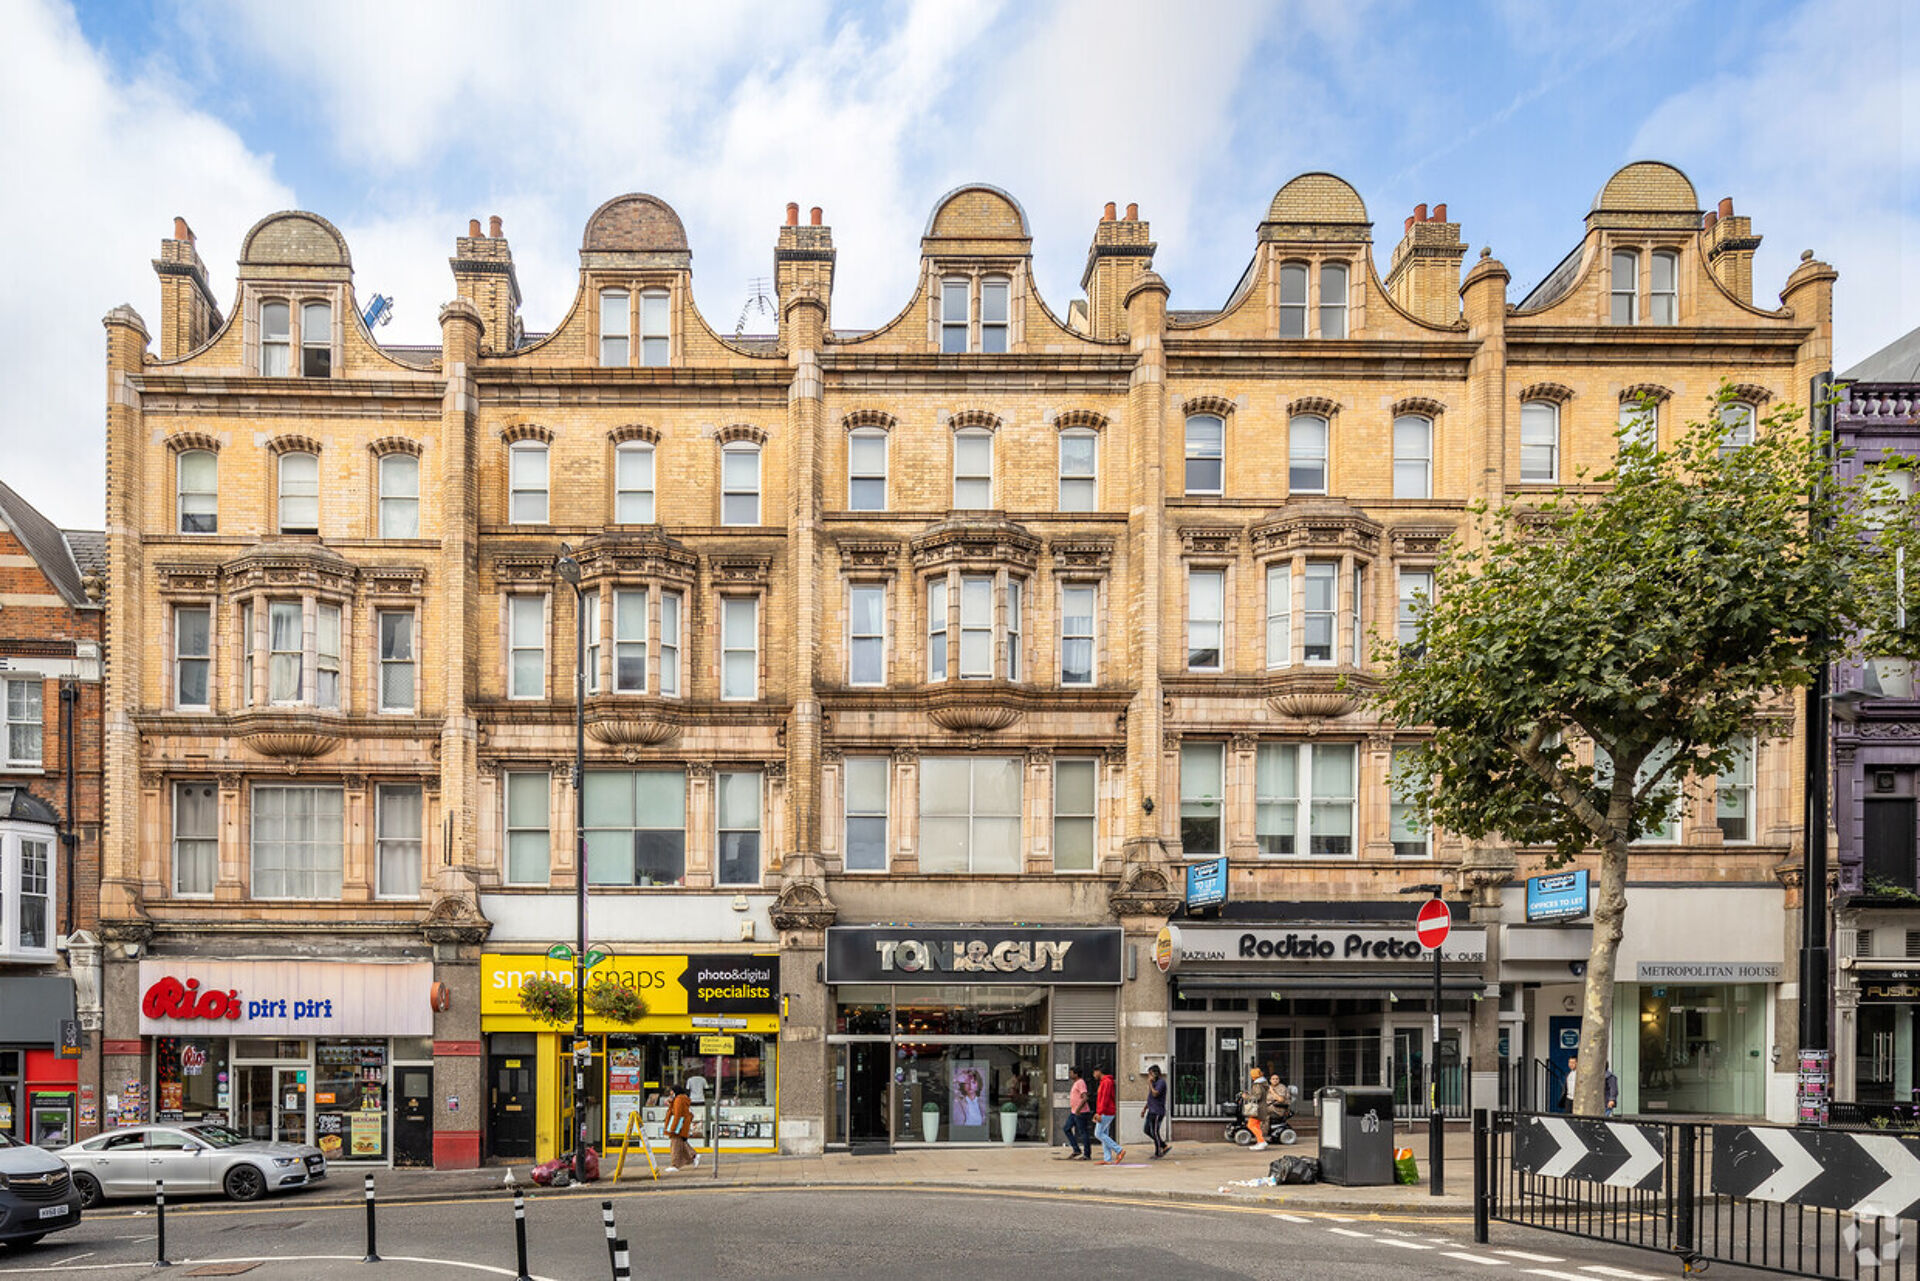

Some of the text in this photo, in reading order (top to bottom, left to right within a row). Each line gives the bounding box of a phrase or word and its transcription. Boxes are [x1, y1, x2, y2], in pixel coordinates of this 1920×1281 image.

[1530, 901, 1558, 910] OFFICES
[1571, 897, 1583, 905] LET
[1239, 933, 1422, 959] Rodizio Preto
[876, 940, 1074, 973] TONI&GUY
[1181, 951, 1225, 960] RAZILIAN
[1422, 952, 1451, 961] STAK
[698, 968, 770, 983] photo&digital
[1641, 966, 1780, 977] METROPOLITAN HOUSE
[142, 976, 242, 1020] Rio's
[698, 983, 770, 1002] specialists
[249, 999, 332, 1020] piri piri
